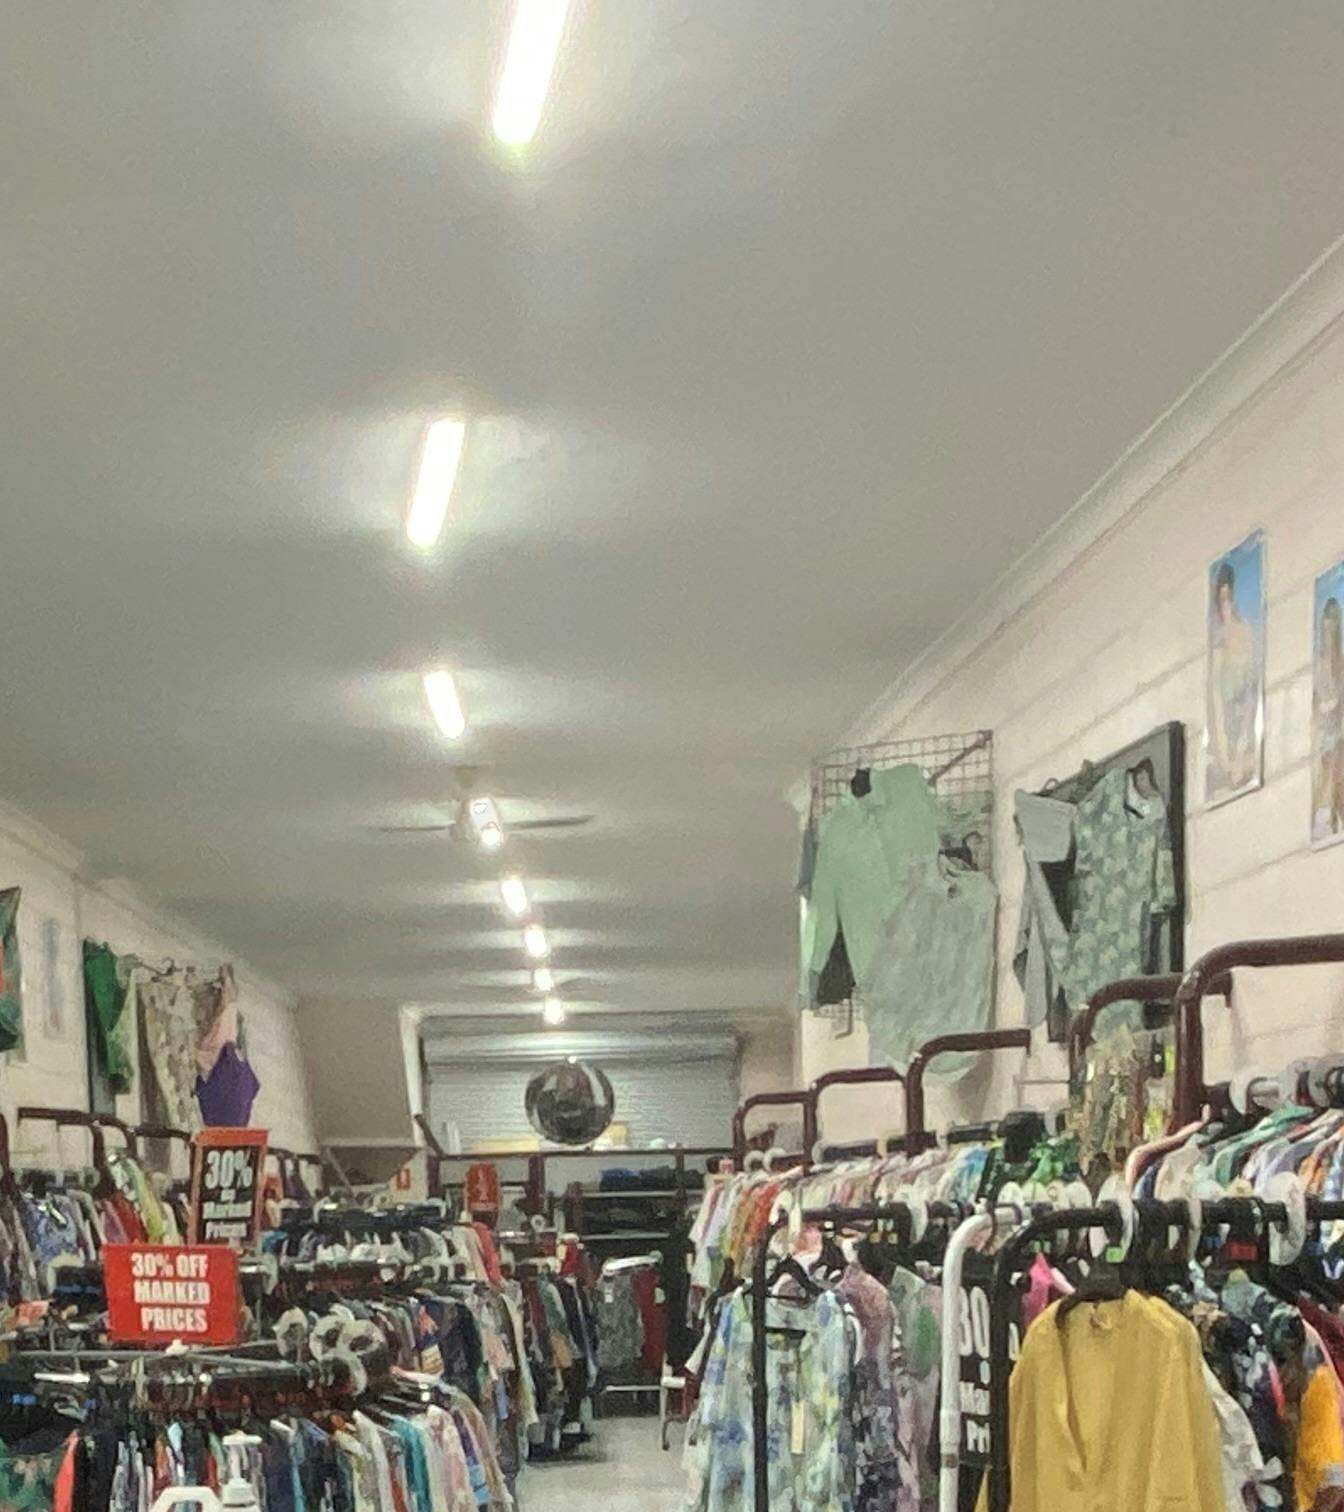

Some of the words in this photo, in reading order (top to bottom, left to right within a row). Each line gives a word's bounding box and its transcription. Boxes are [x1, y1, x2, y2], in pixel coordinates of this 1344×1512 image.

[205, 1149, 253, 1190] 30%
[131, 1252, 174, 1278] 30%
[176, 1254, 208, 1278] OFF
[133, 1279, 211, 1304] MARKED
[140, 1306, 208, 1332] PRICES
